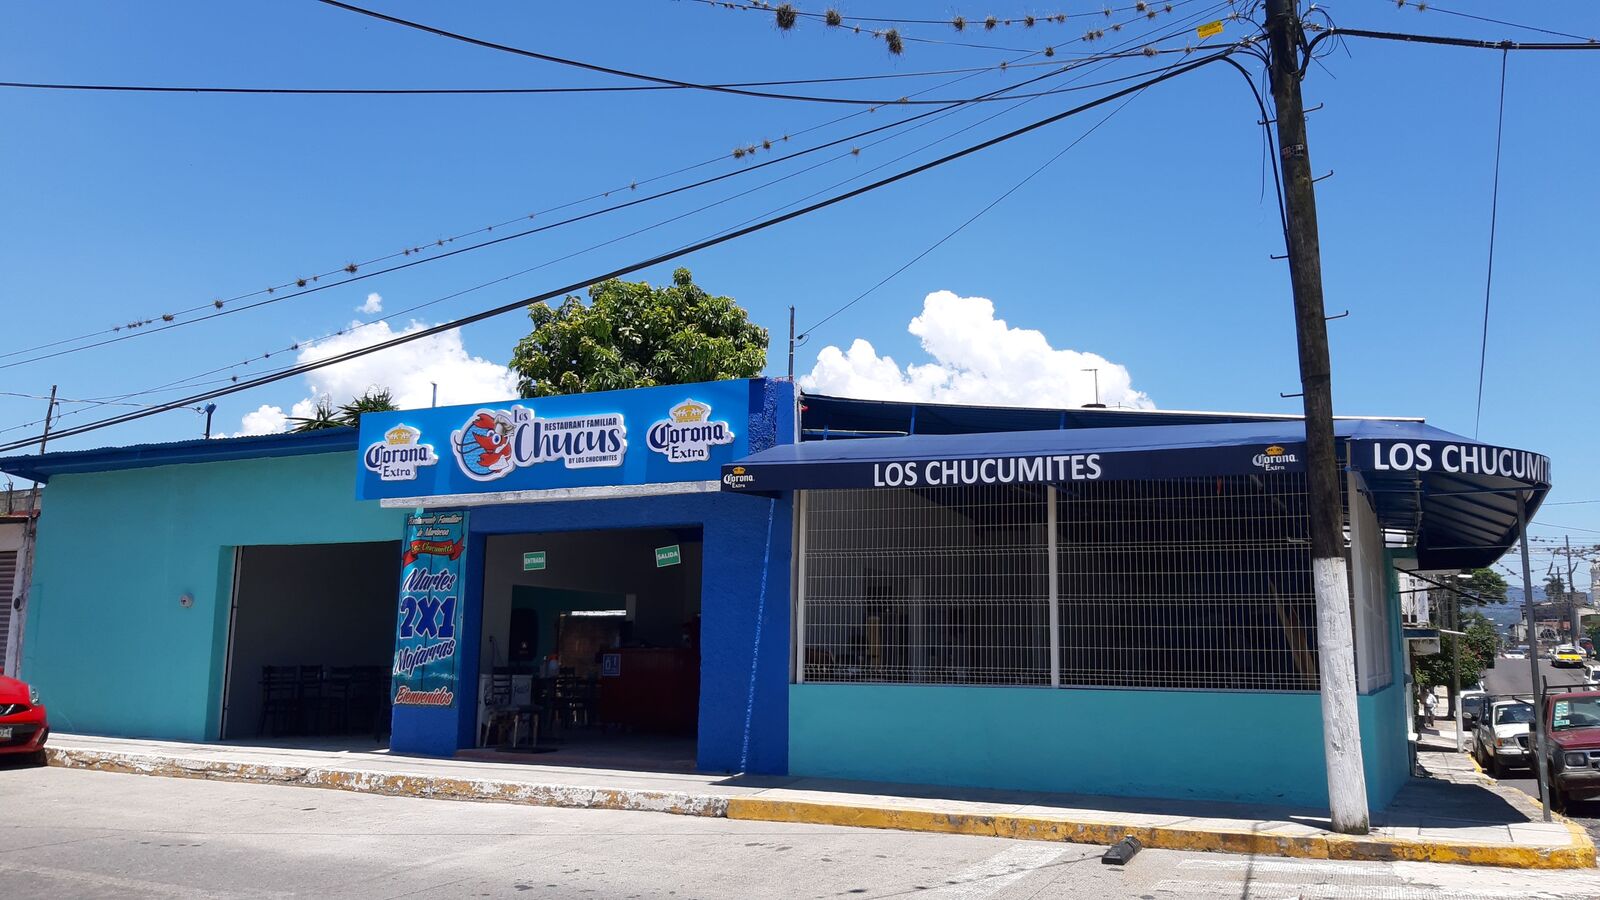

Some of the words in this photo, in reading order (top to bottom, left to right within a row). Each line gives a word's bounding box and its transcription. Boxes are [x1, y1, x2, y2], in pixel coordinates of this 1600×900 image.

[513, 408, 529, 424] Los
[544, 420, 586, 432] RESTAURANT
[586, 417, 617, 428] FAMILIAR
[514, 421, 621, 464] Chucus
[649, 422, 725, 450] Corona
[365, 445, 429, 469] Corona
[670, 446, 705, 459] Extra
[1252, 453, 1296, 468] Corona
[1374, 442, 1432, 471] LOS
[383, 466, 411, 478] Extra
[873, 460, 918, 487] LOS
[924, 454, 1101, 485] CHUCUMITES
[1265, 463, 1285, 471] Extra
[723, 473, 754, 485] Corona
[657, 551, 677, 560] SALIDA
[403, 568, 456, 592] Martes
[393, 639, 455, 676] Mojarras
[394, 686, 453, 705] Bienvenidos
